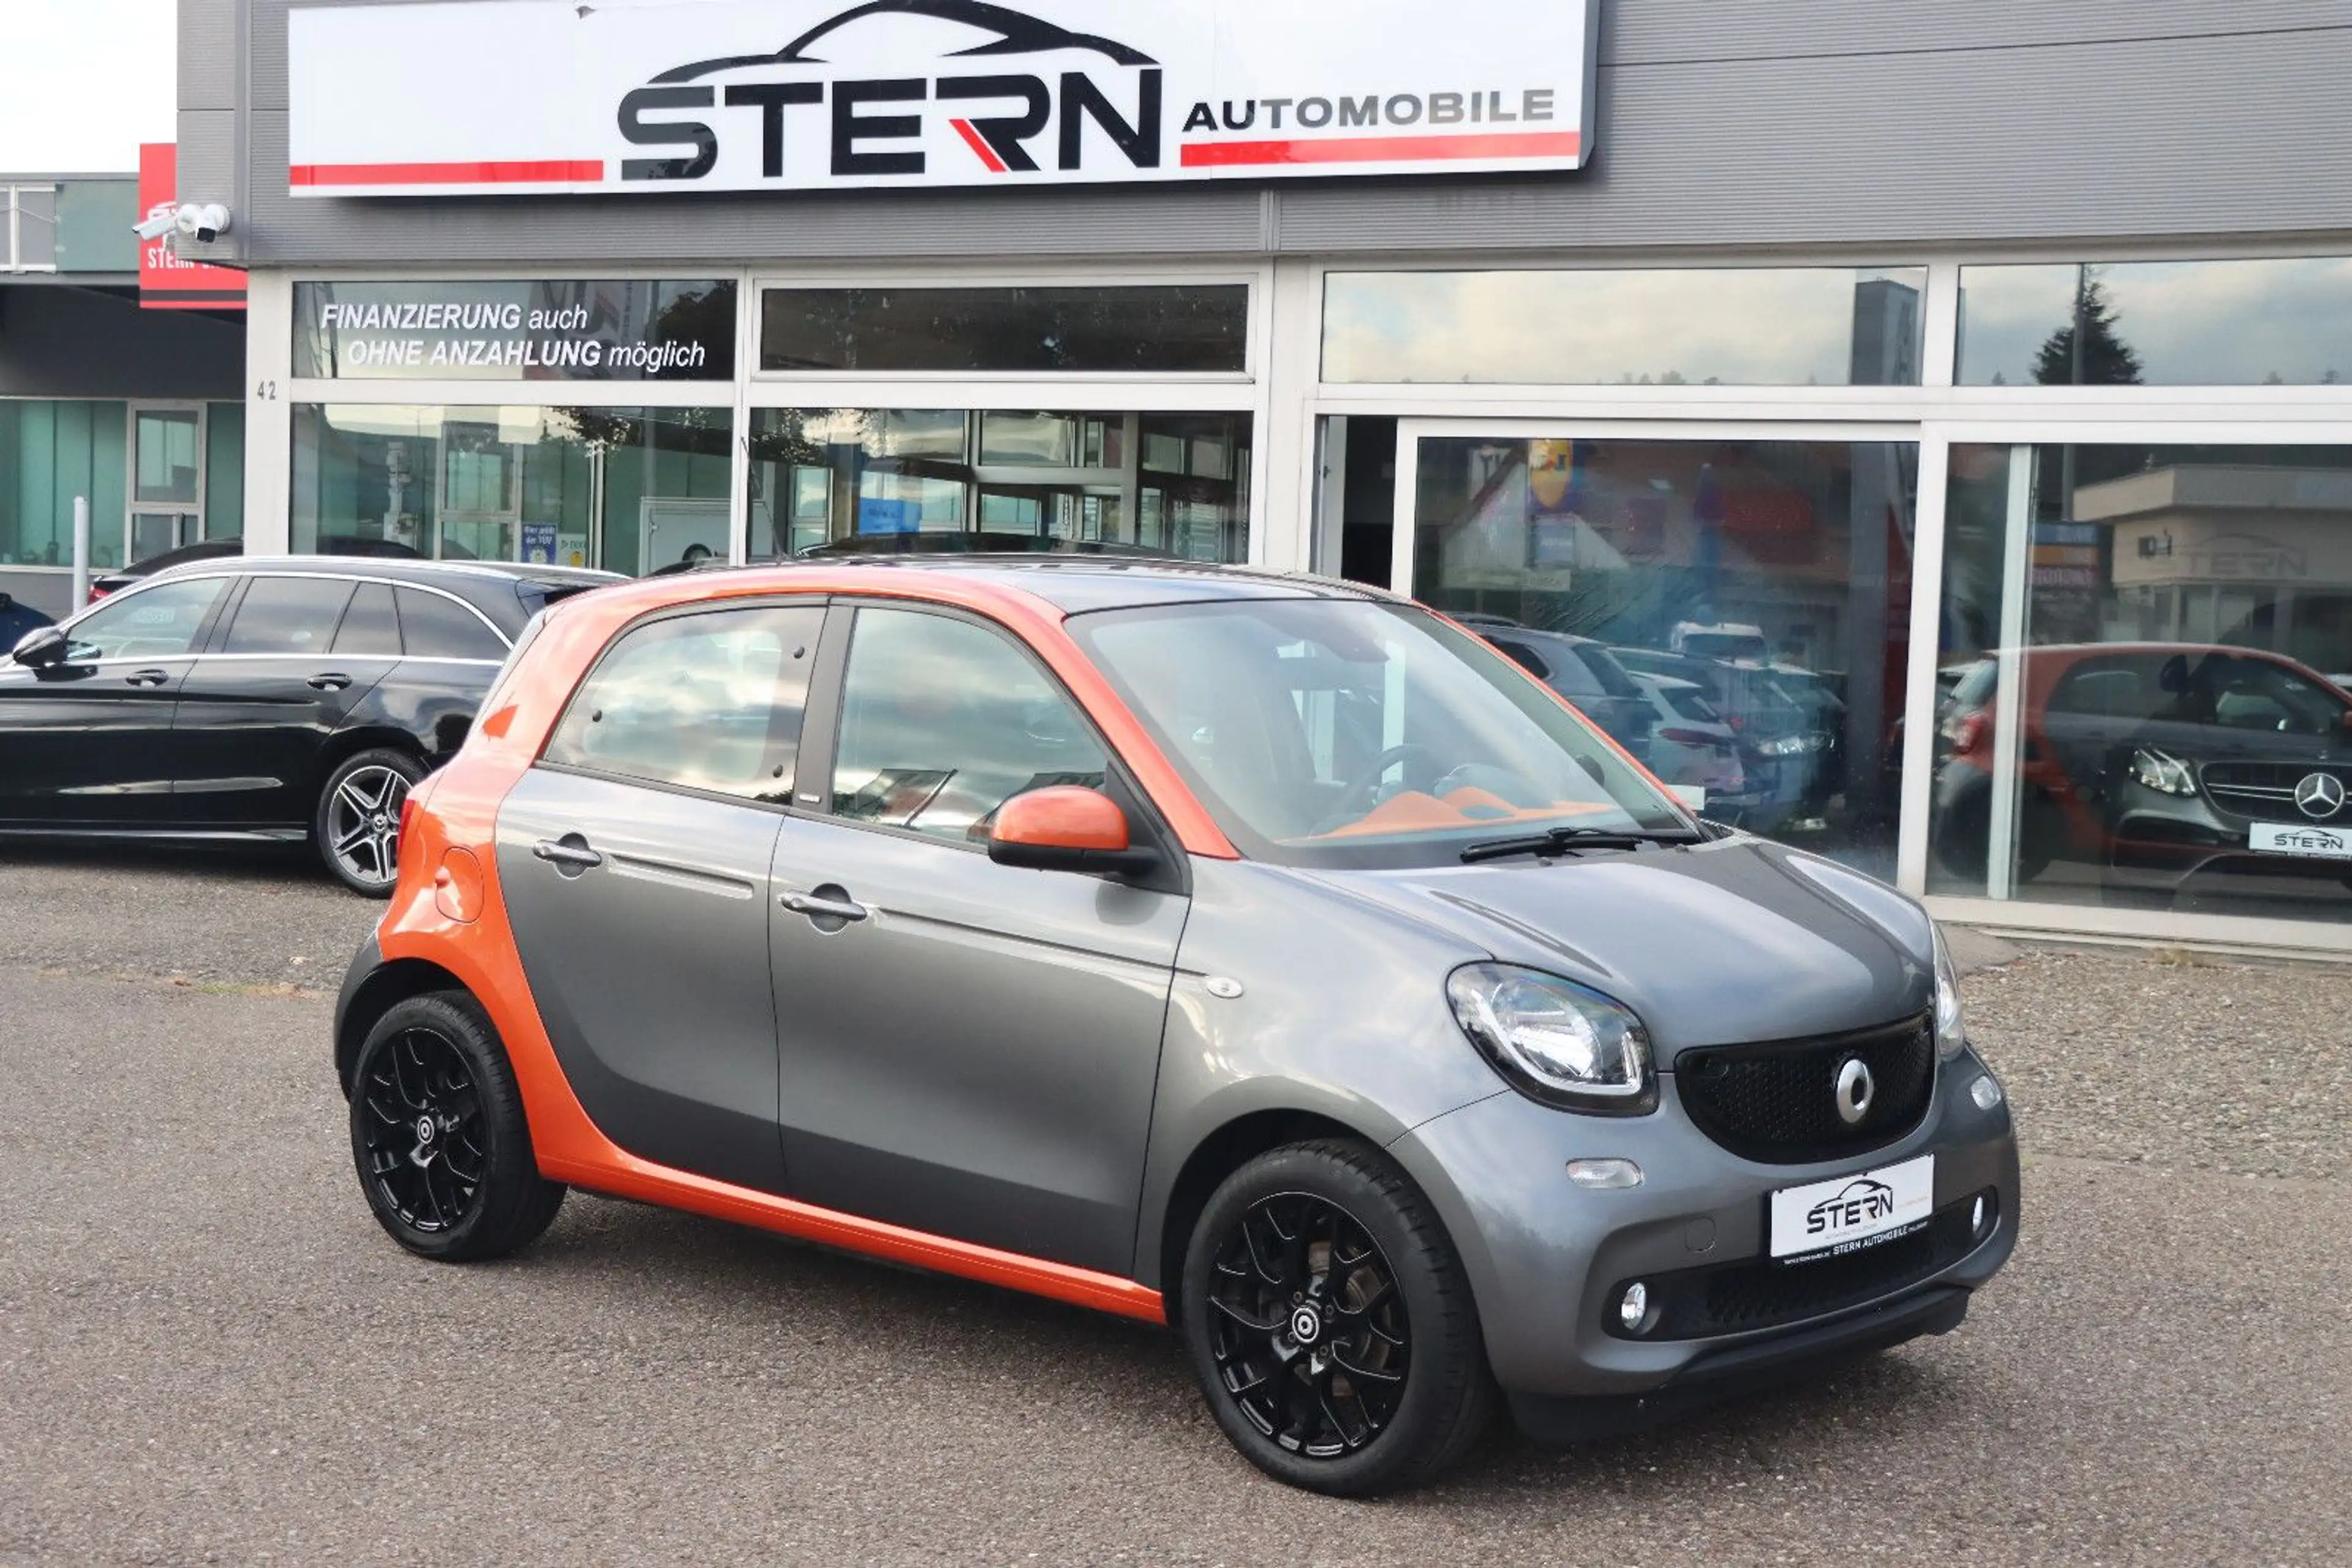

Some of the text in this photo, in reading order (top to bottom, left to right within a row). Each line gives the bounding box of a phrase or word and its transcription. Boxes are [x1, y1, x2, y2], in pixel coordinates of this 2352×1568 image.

[617, 66, 1555, 179] STERN AUTOMOBILE
[321, 303, 588, 330] FINANZIERUNG auch
[348, 339, 705, 373] OHNE ANZAHLUNG möglich
[257, 380, 276, 401] 42
[2274, 834, 2343, 850] STERN
[1807, 1189, 1893, 1234] STERN
[1833, 1238, 1861, 1255] STERN
[1862, 1225, 1908, 1249] AUTOMOBILE
